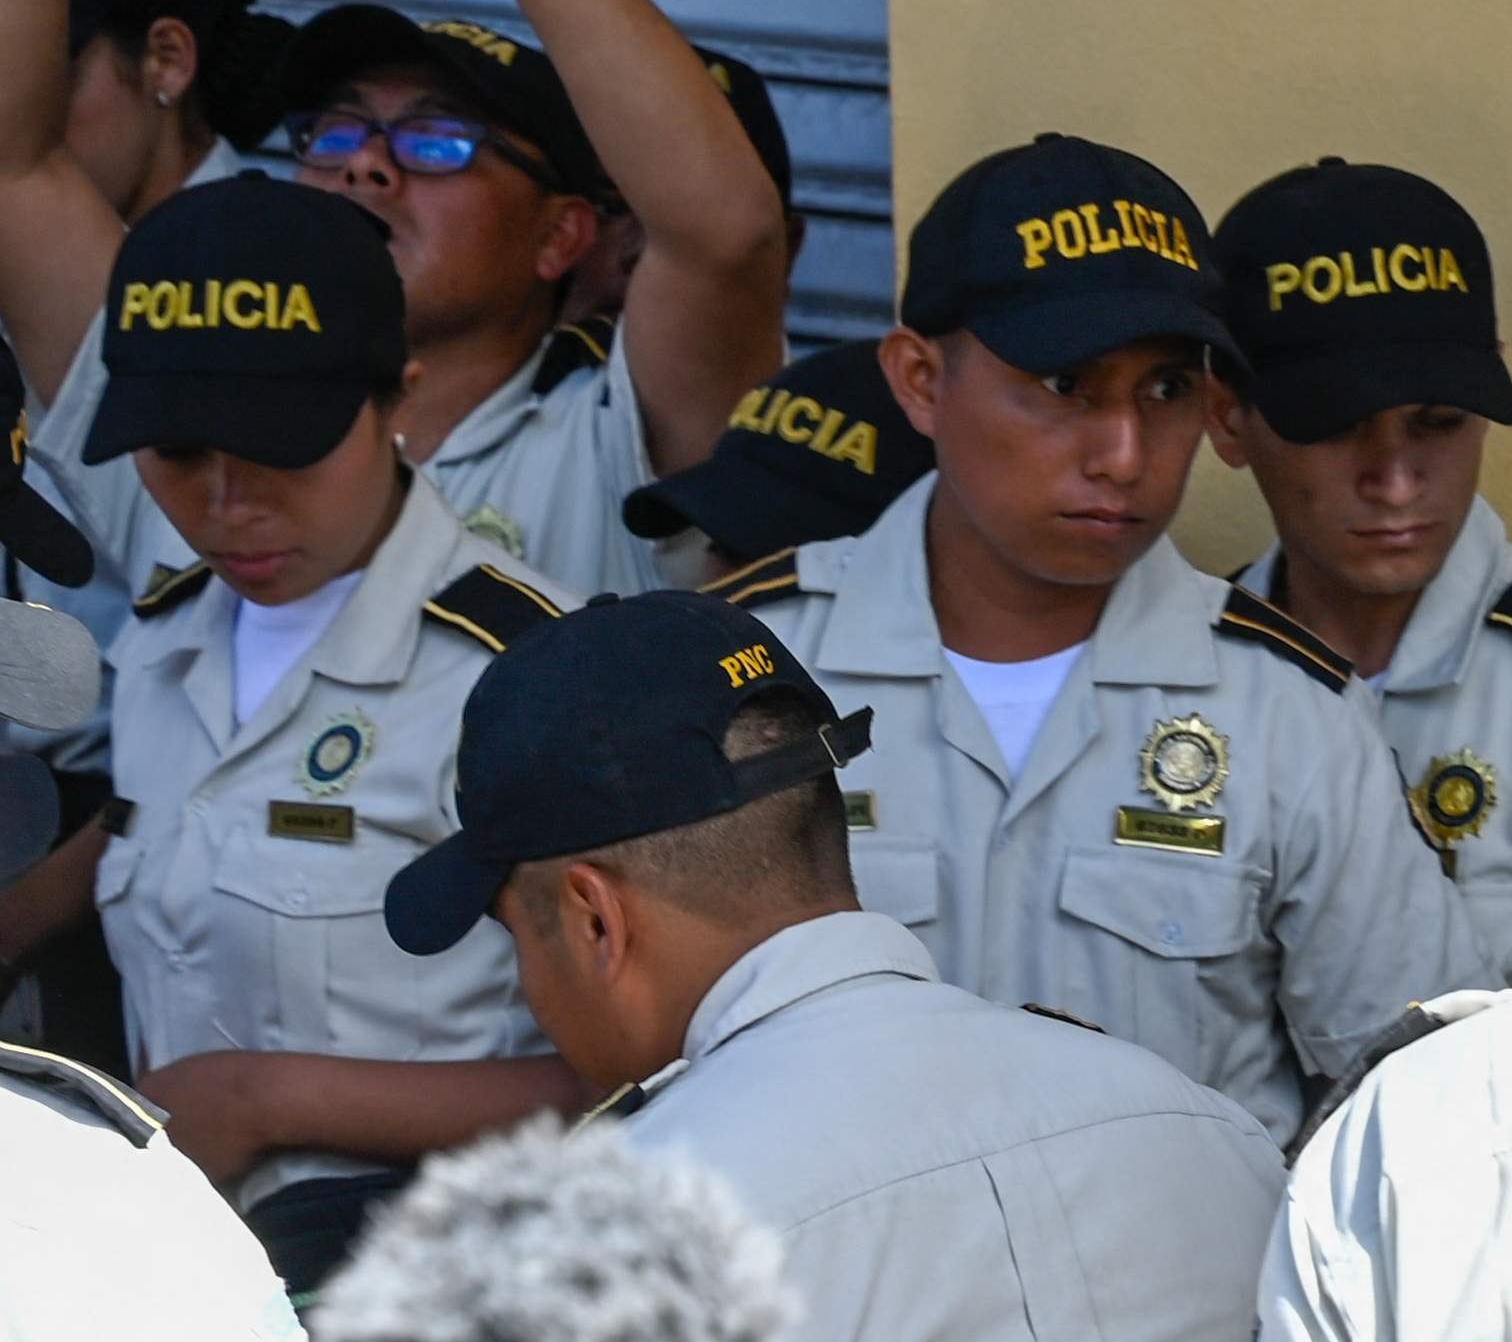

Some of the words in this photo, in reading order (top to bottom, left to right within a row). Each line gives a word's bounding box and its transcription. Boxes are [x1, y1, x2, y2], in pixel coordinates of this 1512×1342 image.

[1016, 199, 1198, 269] POLICIA
[119, 278, 322, 333] POLICIA
[1265, 243, 1467, 311] POLICIA
[728, 386, 879, 475] LICIA
[718, 644, 775, 688] PNC
